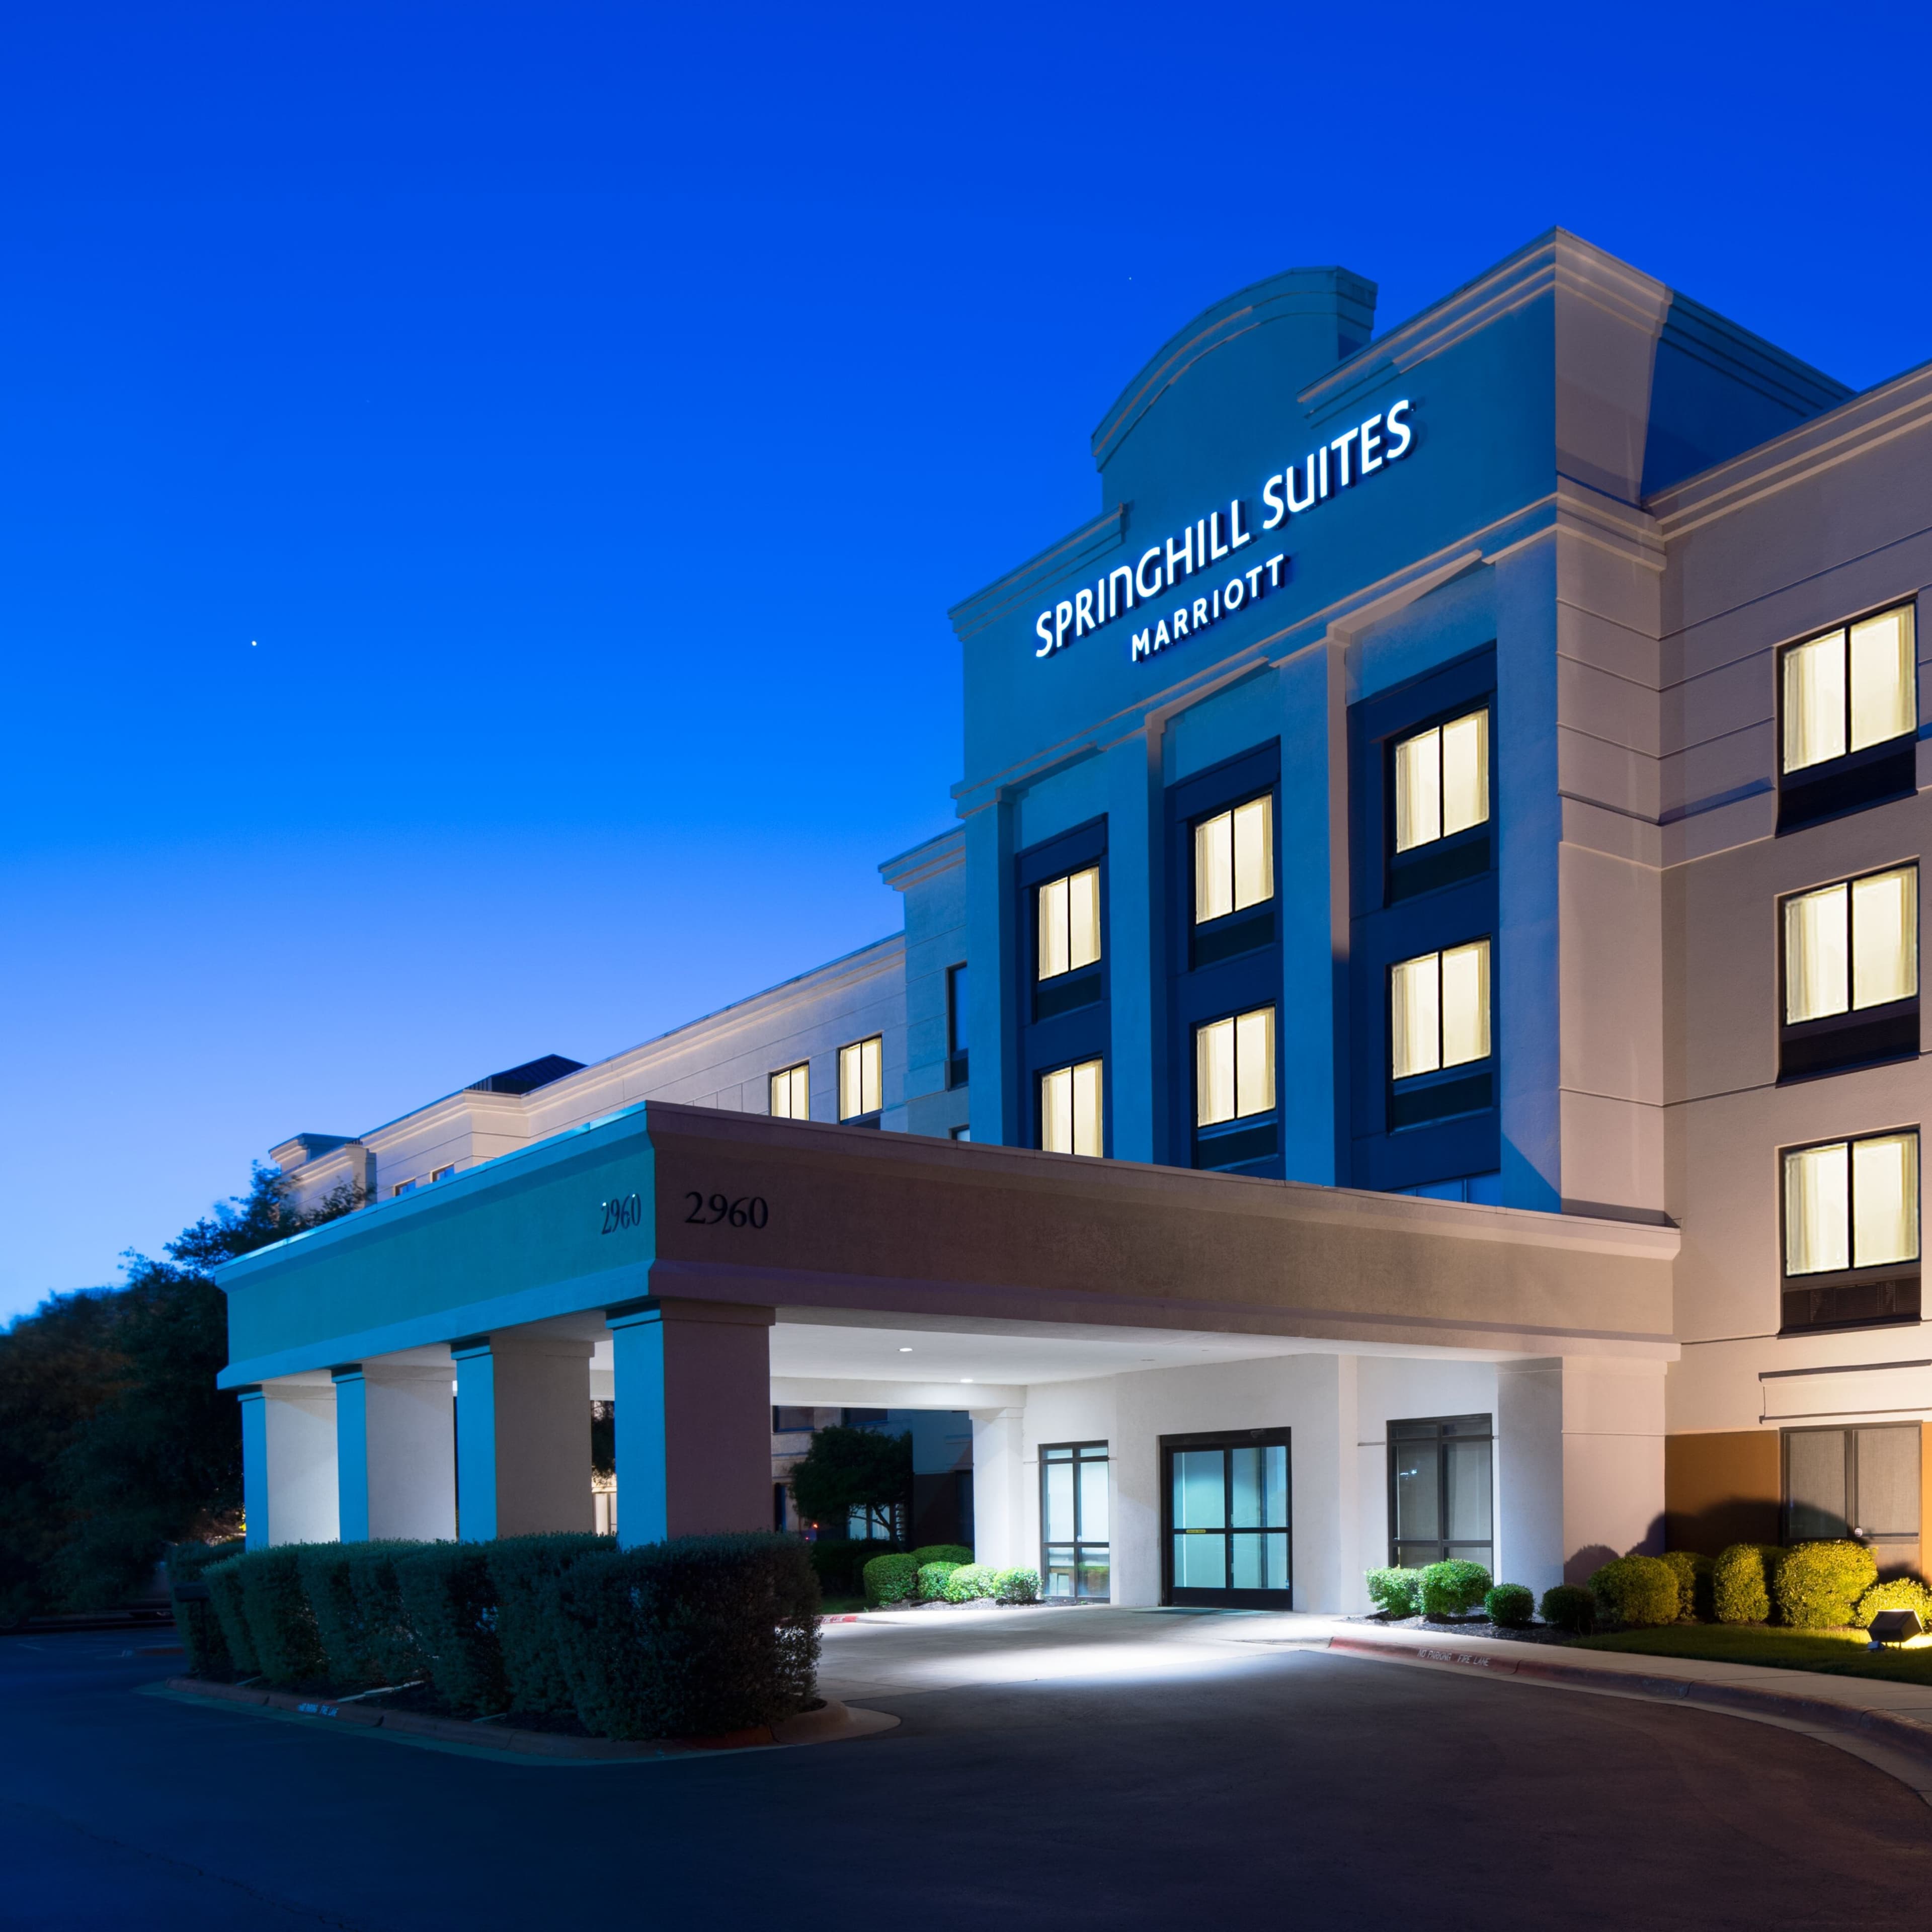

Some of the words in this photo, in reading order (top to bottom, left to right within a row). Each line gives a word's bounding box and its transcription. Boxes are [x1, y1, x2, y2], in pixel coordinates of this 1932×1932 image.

[1035, 499, 1250, 658] SPRINGHILL
[1262, 399, 1411, 530] SUITES
[1132, 553, 1284, 662] MARRIOTT
[601, 1193, 642, 1235] 2960
[684, 1191, 769, 1229] 2960
[1417, 1650, 1427, 1658] NO
[1427, 1650, 1452, 1661] PARKING
[1457, 1654, 1472, 1663] FIRE
[1473, 1657, 1491, 1666] LANE
